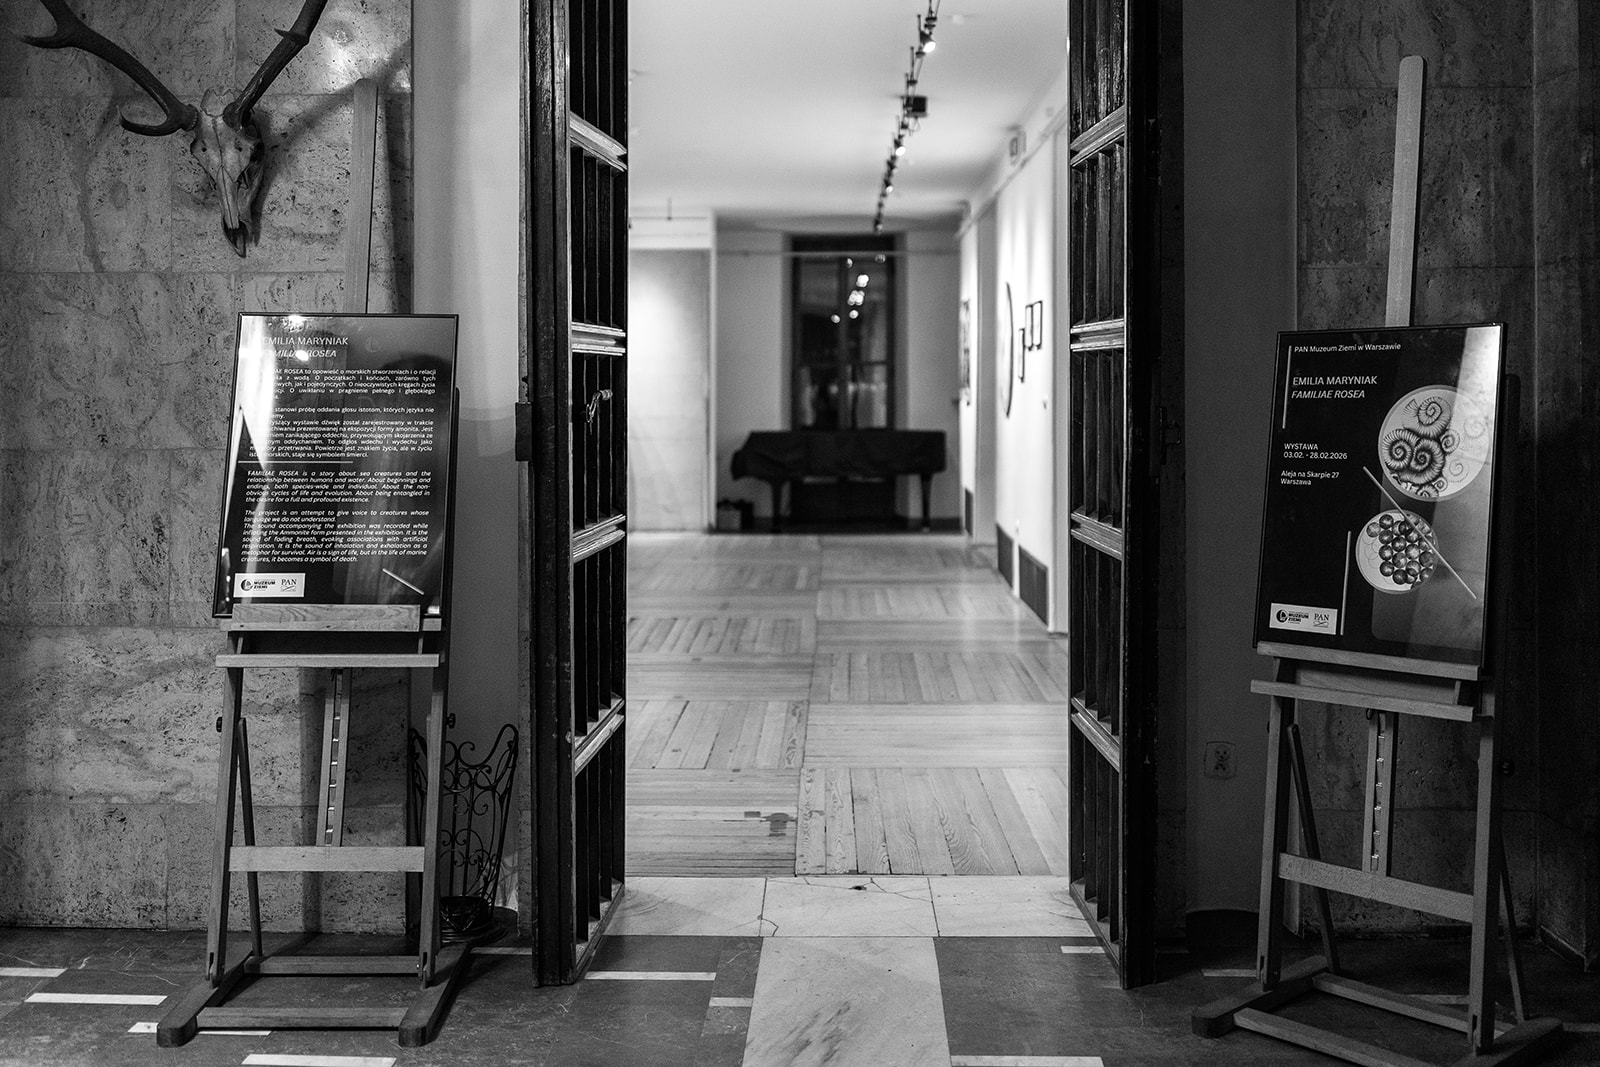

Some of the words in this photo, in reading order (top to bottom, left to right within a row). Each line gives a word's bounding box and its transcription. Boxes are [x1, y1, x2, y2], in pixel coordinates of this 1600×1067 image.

[298, 337, 348, 345] MARYNIAK
[1293, 377, 1324, 385] EMILIA
[1326, 376, 1378, 385] MARYNIAK
[1292, 390, 1333, 398] FAMILIAE
[1334, 390, 1365, 398] ROSEA
[1307, 471, 1330, 479] Skarpie
